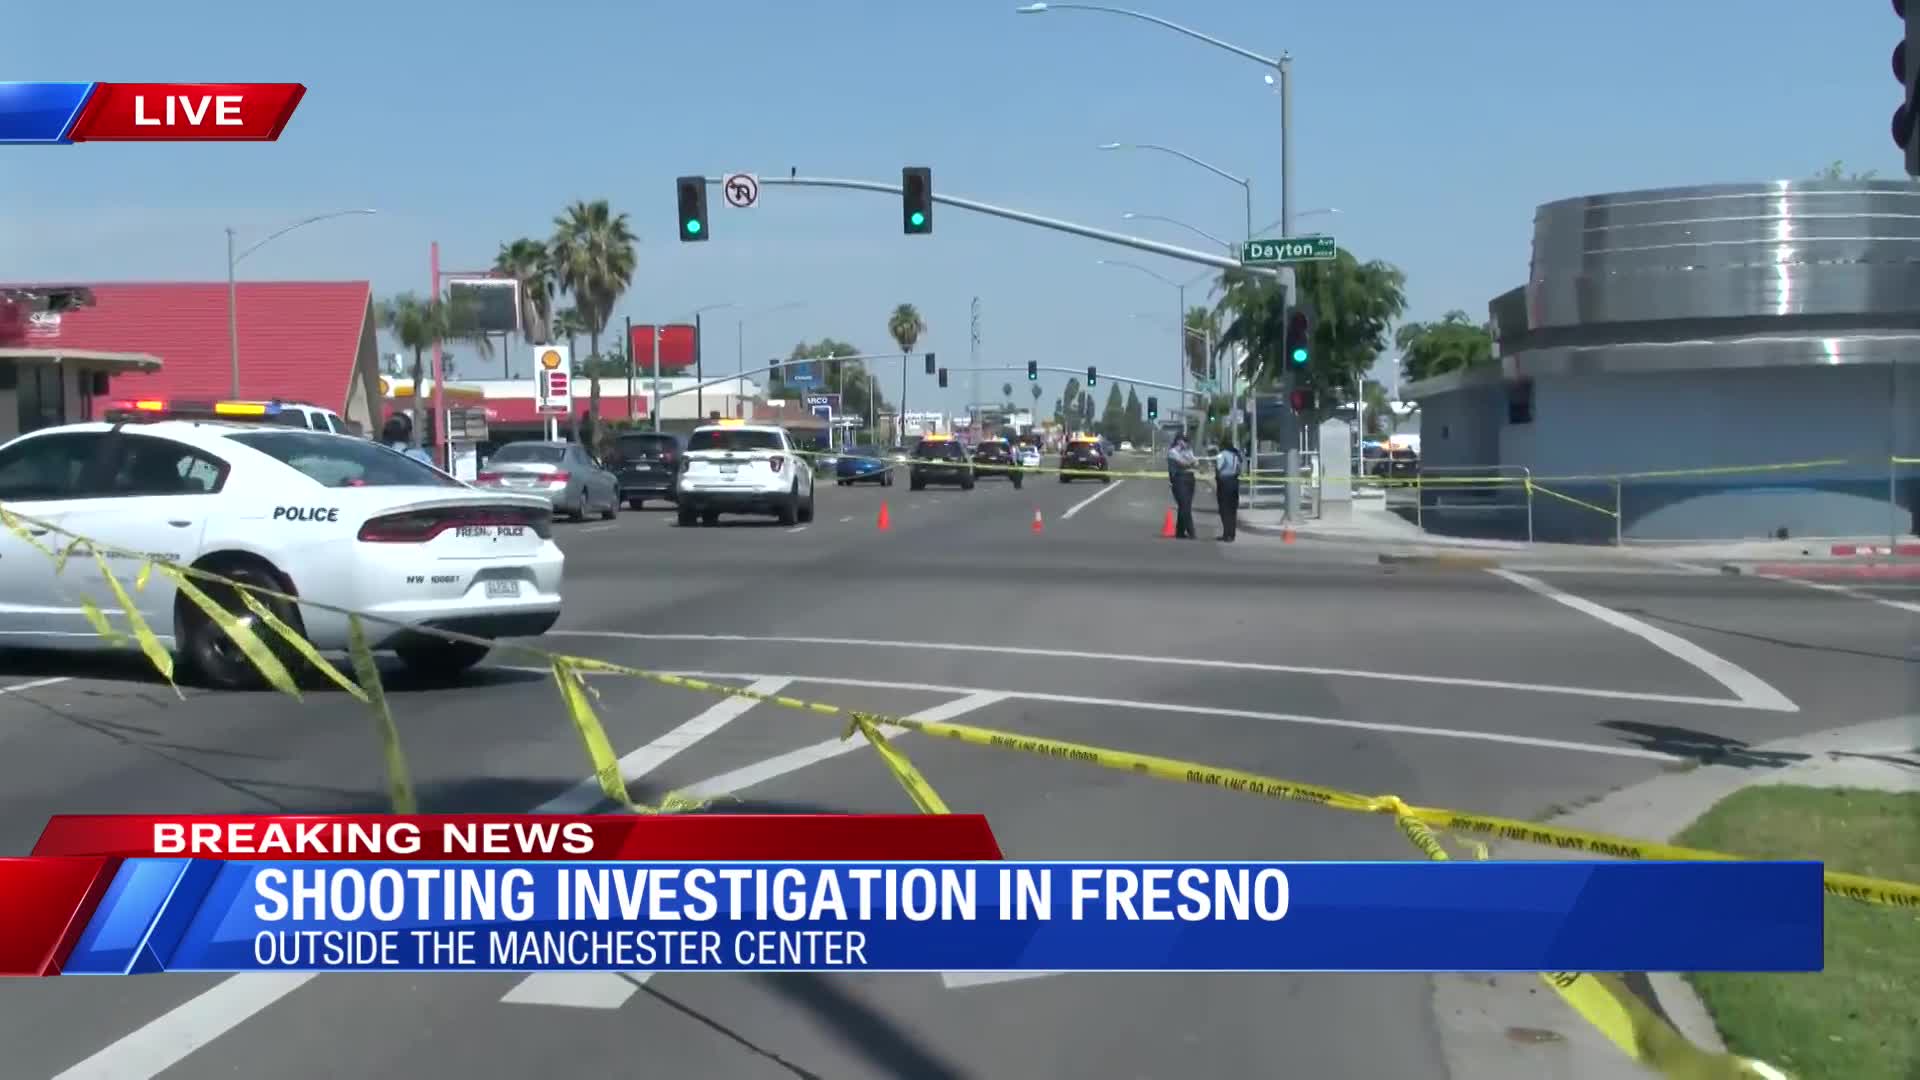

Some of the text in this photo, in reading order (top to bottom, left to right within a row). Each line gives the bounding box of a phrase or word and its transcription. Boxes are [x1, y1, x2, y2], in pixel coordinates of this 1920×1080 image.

[1251, 243, 1313, 261] Dayton
[273, 505, 340, 522] POLICE
[497, 526, 524, 537] POLICE
